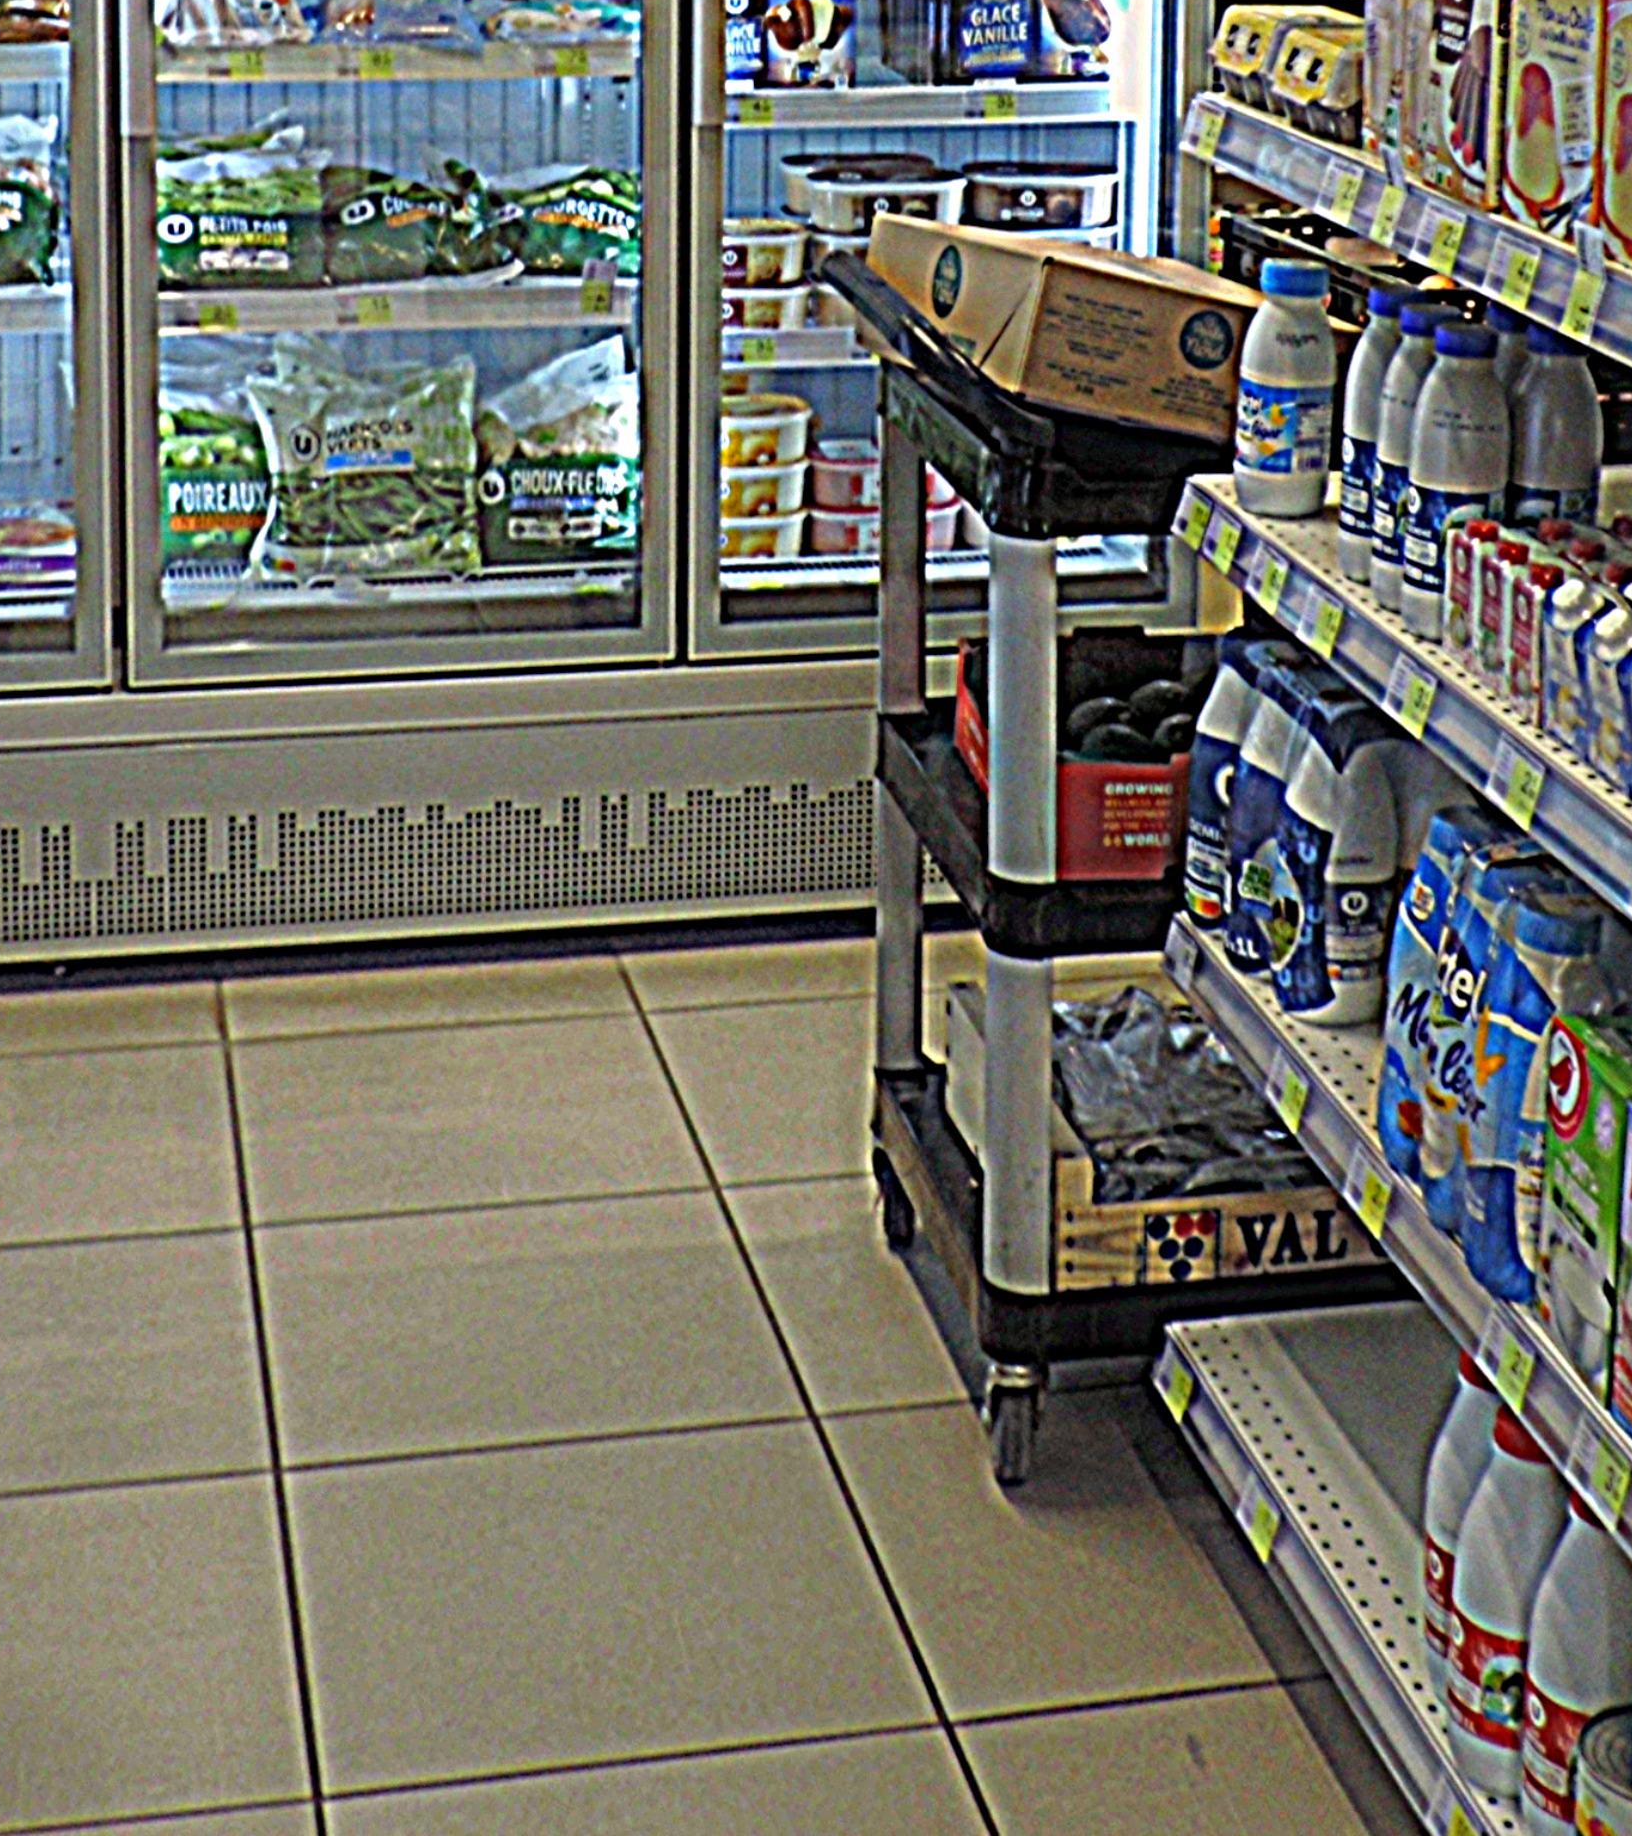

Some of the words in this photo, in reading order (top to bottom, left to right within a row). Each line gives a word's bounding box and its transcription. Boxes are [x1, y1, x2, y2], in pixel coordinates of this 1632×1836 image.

[970, 4, 1021, 26] GLACE
[962, 23, 1027, 47] VANILLE
[169, 480, 267, 514] POIREAUX
[1238, 1209, 1347, 1266] VAL
